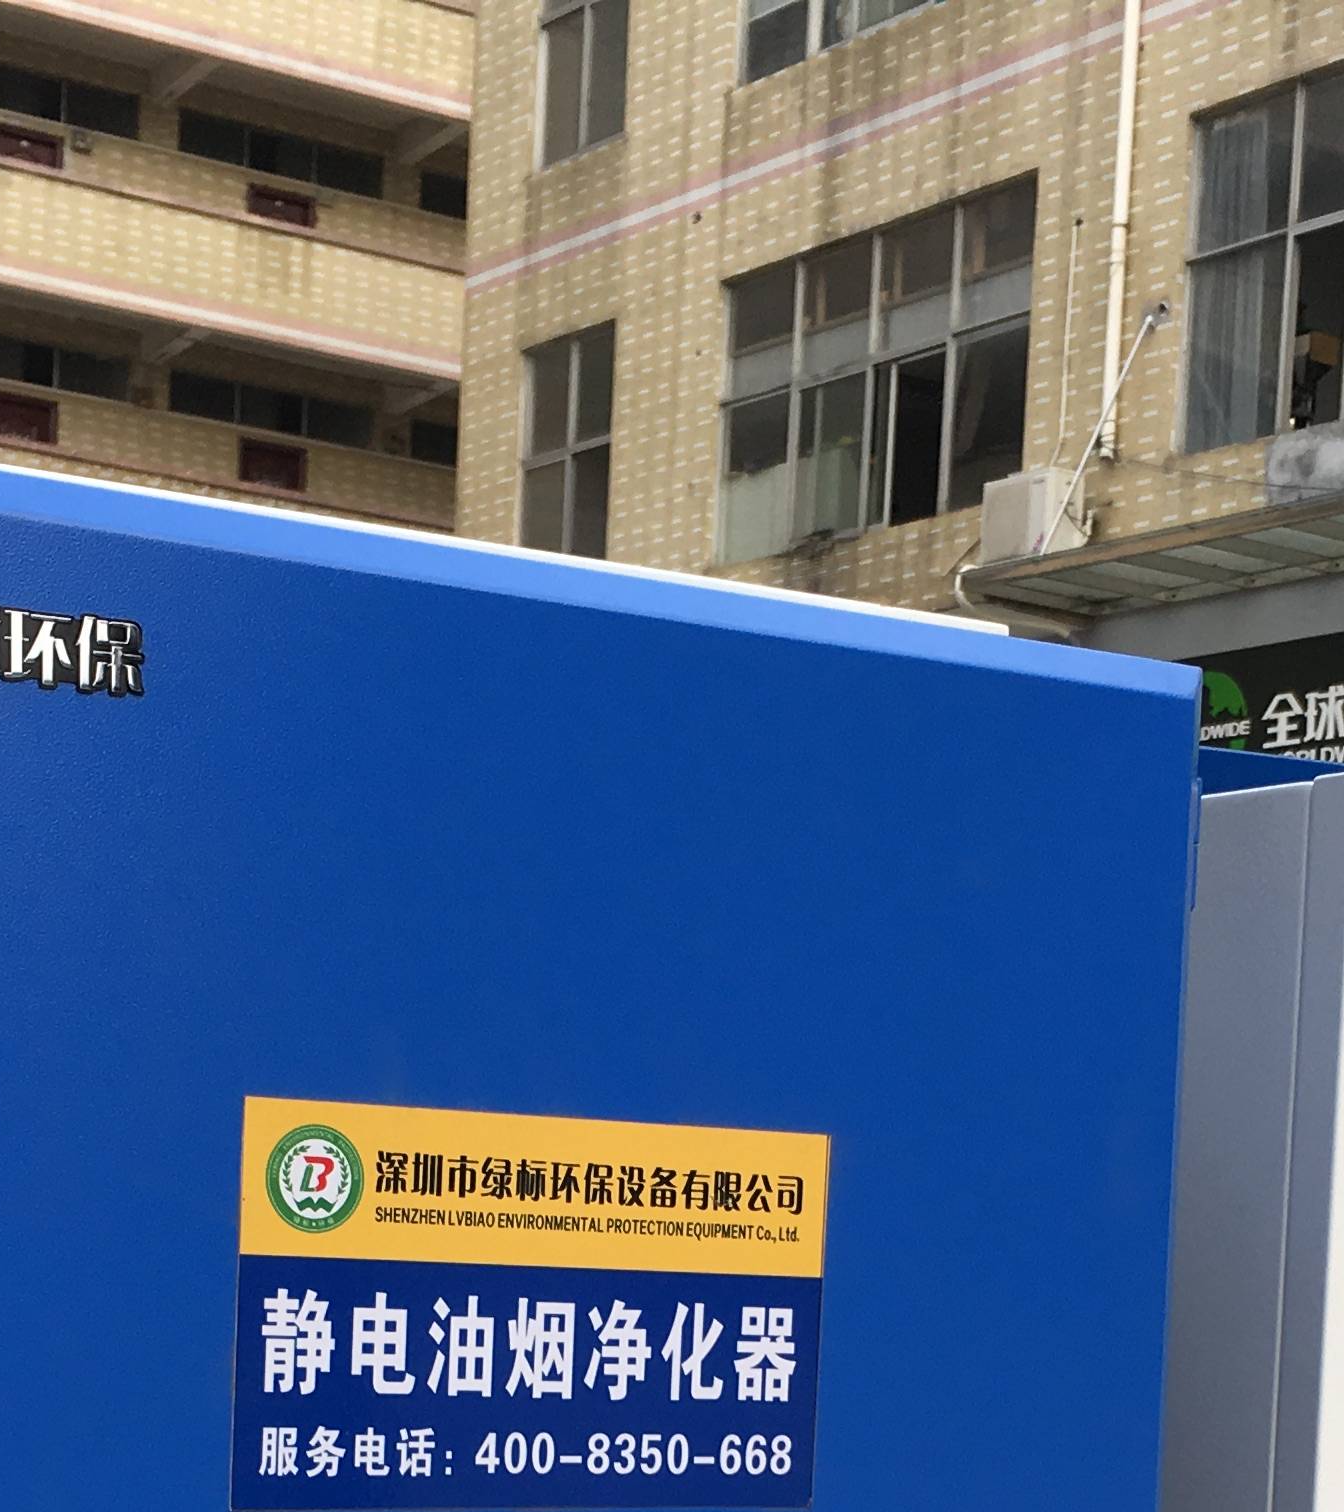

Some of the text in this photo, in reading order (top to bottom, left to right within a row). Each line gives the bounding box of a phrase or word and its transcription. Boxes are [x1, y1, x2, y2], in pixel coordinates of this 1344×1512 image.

[375, 1150, 804, 1216] 深圳市绿标环保设备有限公司
[375, 1207, 446, 1226] SHENZHEN
[448, 1210, 495, 1228] LVBIAO
[497, 1212, 604, 1233] ENVIRONMENTAL
[606, 1217, 684, 1237] PROTECTION
[686, 1222, 754, 1241] EQUIPMENT
[778, 1227, 800, 1242] Ltd.
[261, 1288, 797, 1402] 静电油烟净化器
[475, 1431, 792, 1476] 400-8350-668
